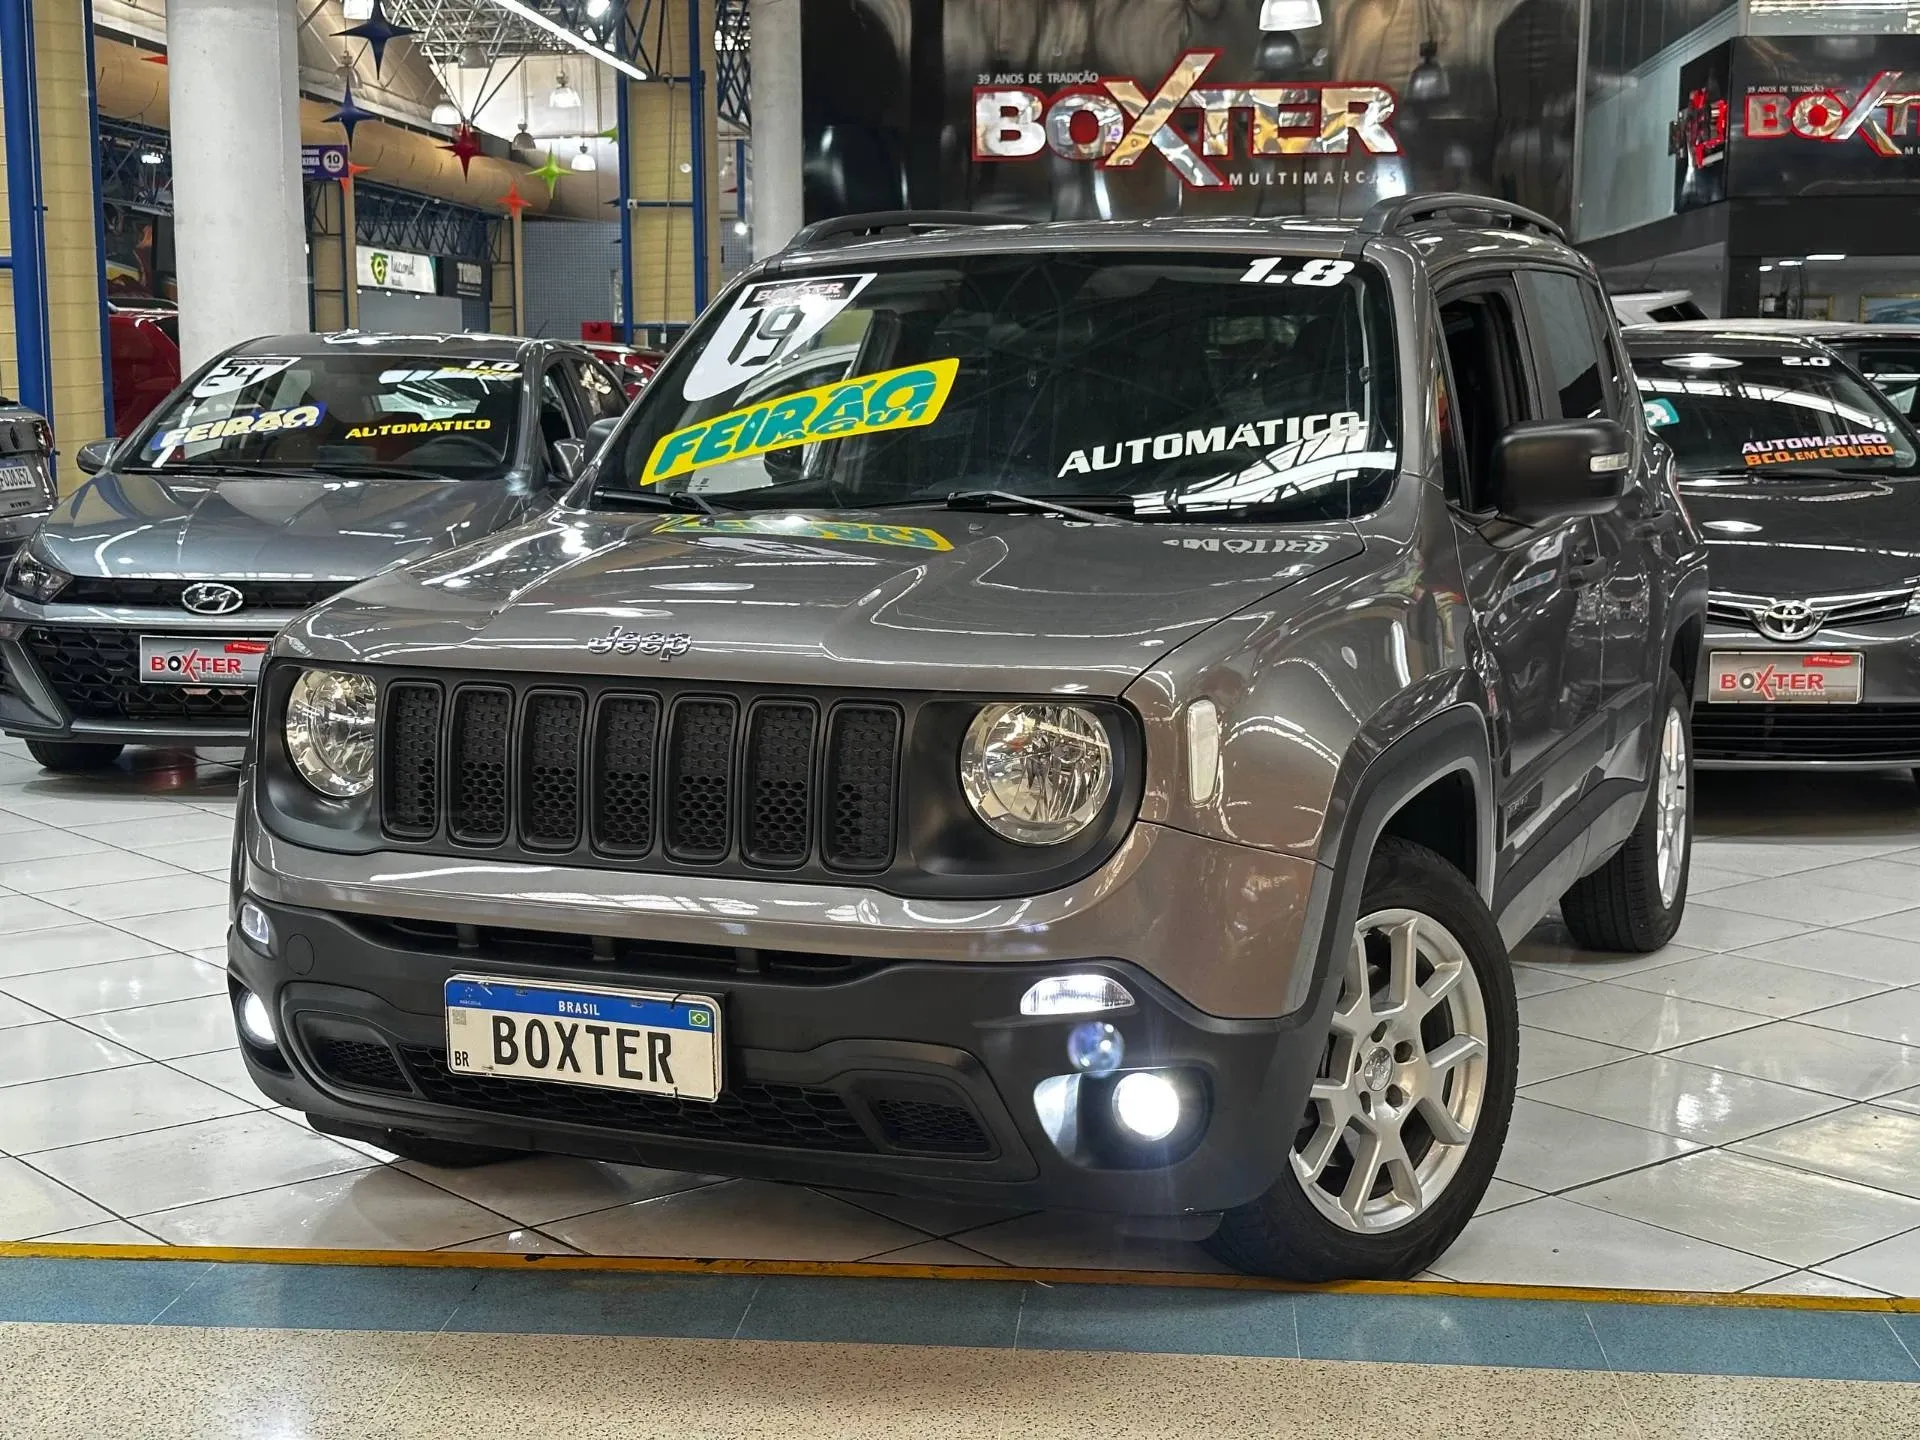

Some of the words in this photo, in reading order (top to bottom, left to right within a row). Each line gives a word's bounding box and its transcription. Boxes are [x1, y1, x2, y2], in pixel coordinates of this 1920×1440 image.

[977, 74, 990, 84] 39
[994, 74, 1025, 84] ANOS
[1028, 73, 1042, 84] DE
[1047, 70, 1099, 85] TRADIÇÃO
[1758, 85, 1777, 93] ANOS
[972, 48, 1402, 190] BOXTER
[1744, 71, 1920, 157] BOXT
[326, 154, 341, 165] 10
[1240, 257, 1355, 287] 1.8
[727, 304, 806, 367] 19
[1781, 356, 1831, 367] 2.0
[345, 419, 491, 439] AUTOMATICO
[1742, 433, 1887, 454] AUTOMATICO
[1796, 450, 1819, 461] EM
[1819, 445, 1895, 458] COURO
[587, 625, 692, 662] Jeep
[150, 648, 243, 682] BOXTER
[1719, 663, 1824, 700] BOXTER
[558, 1000, 600, 1016] BRASIL
[455, 1051, 469, 1067] BR
[492, 1015, 674, 1084] BOXTER
